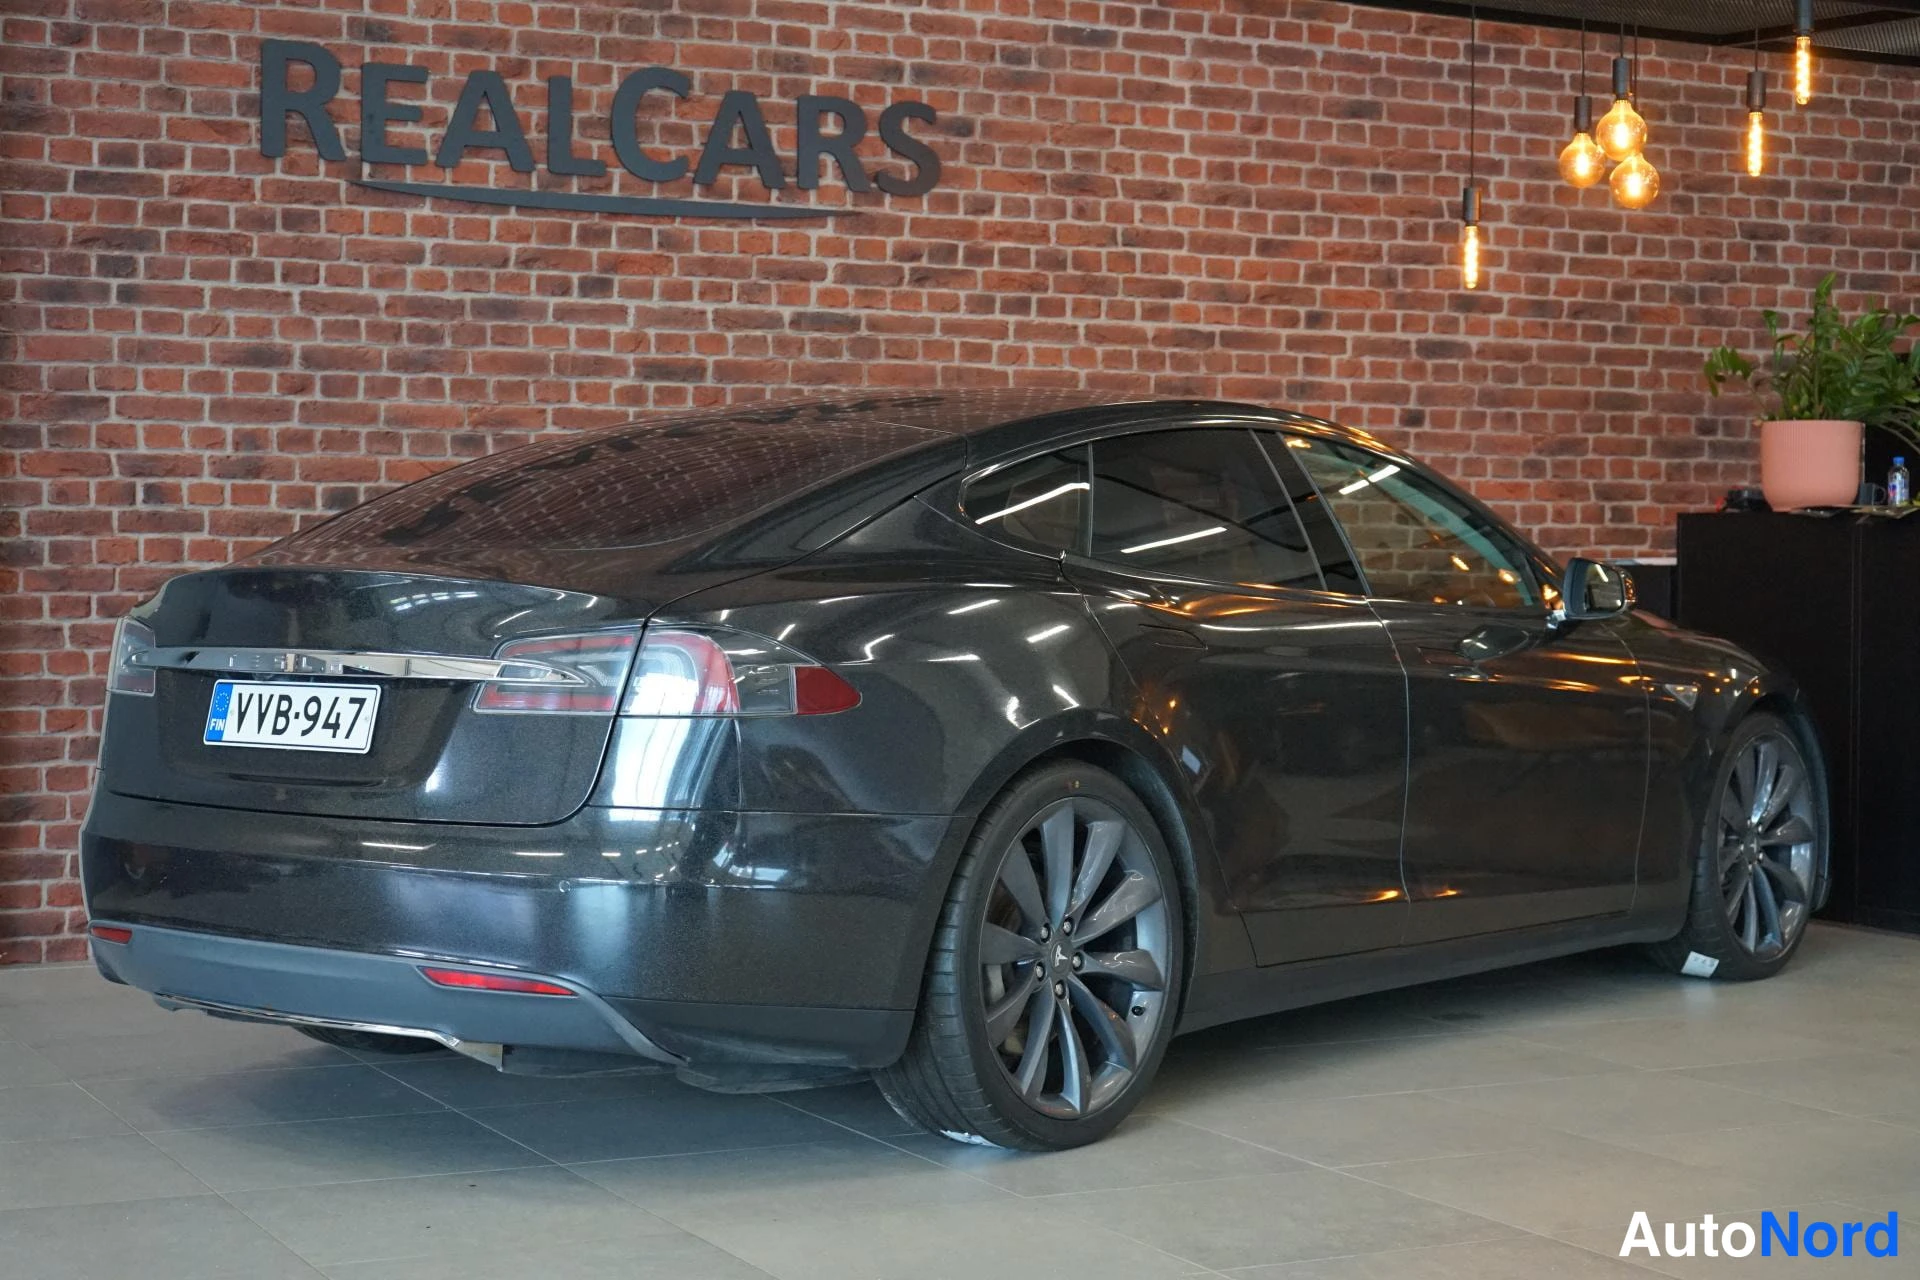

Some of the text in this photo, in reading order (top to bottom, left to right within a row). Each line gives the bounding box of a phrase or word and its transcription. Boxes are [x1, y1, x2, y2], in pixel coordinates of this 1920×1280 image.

[260, 39, 942, 197] REALCARS
[209, 718, 226, 732] FIN
[237, 692, 368, 740] VVB-947
